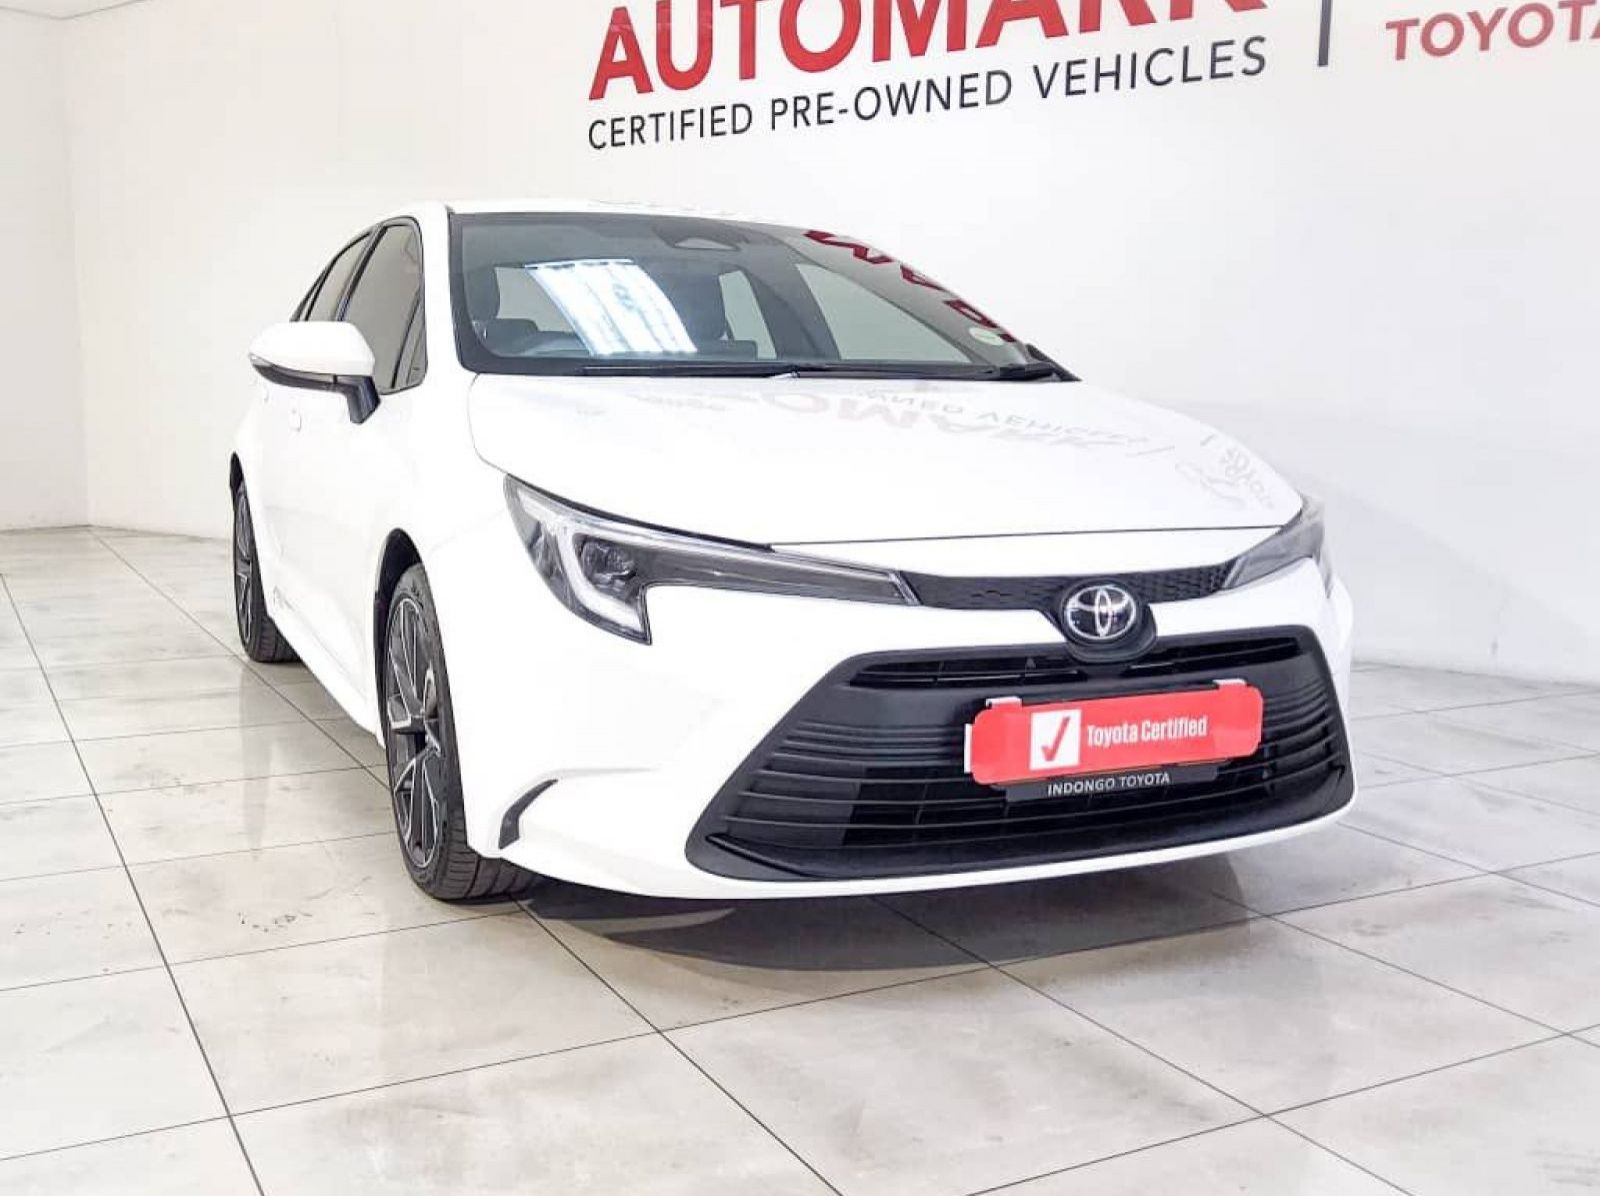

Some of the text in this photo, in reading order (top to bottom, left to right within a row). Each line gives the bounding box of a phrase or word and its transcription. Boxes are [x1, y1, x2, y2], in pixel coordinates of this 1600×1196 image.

[588, 0, 1268, 100] AUTOM
[1385, 0, 1600, 61] TOYOT
[588, 36, 1267, 150] CERTIFIED PRE-OWNED VEHICLES
[1087, 715, 1208, 748] Toyota Certified
[1047, 771, 1170, 797] INDONGO TOYOTA
